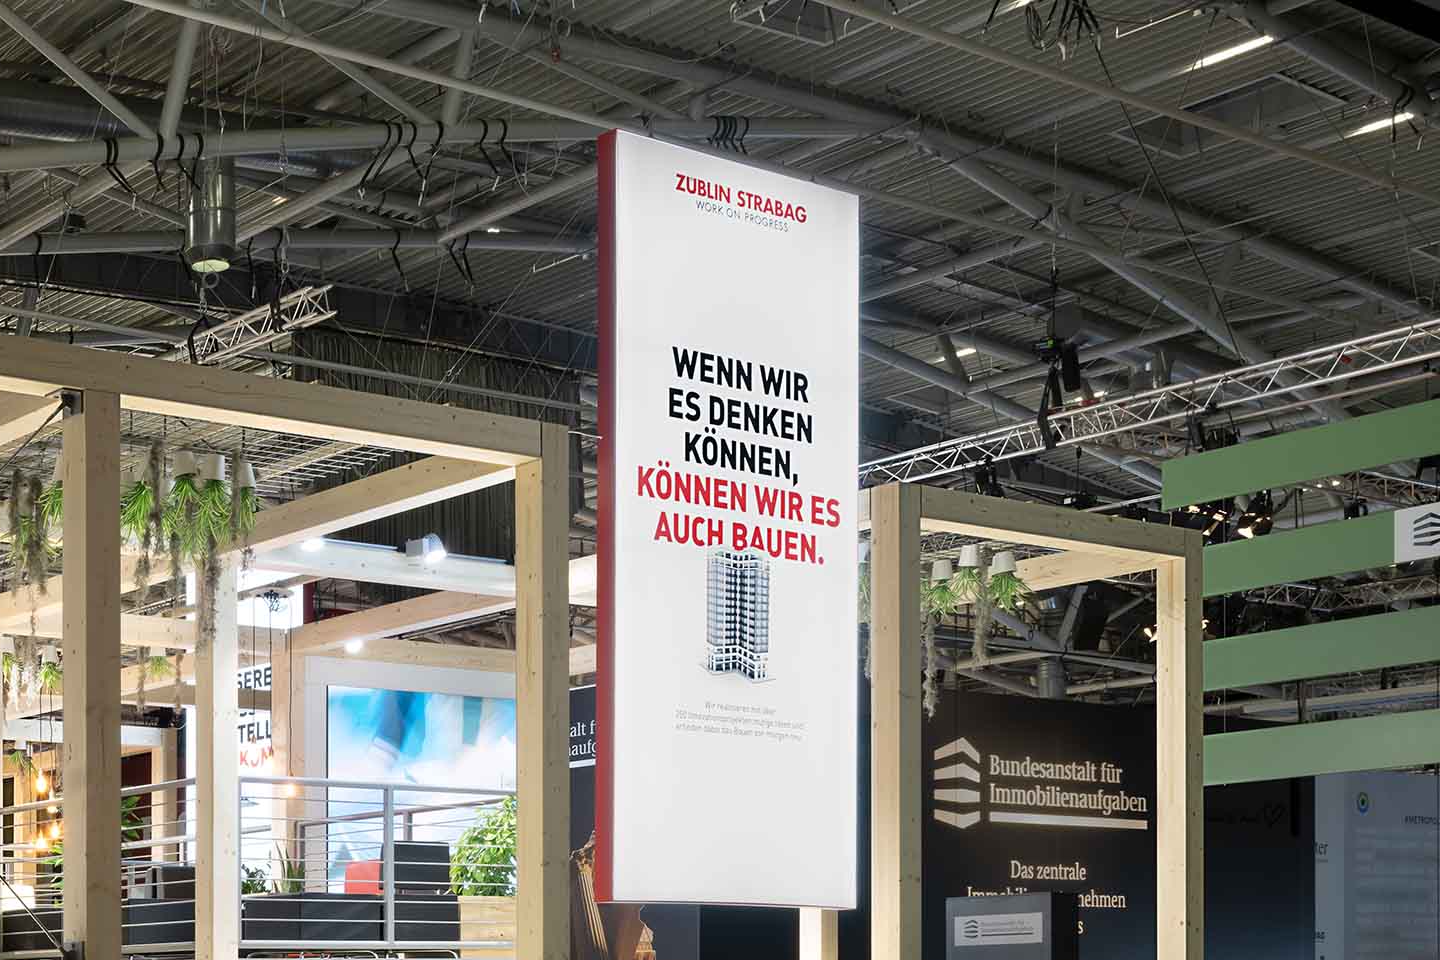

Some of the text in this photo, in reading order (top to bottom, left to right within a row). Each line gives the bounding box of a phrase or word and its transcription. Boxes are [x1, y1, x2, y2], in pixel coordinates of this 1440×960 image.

[696, 200, 789, 232] WORK ON PROGRESS
[737, 190, 807, 223] STRABAG
[672, 346, 809, 403] WENN WIR
[669, 387, 813, 443] ES DENKEN
[684, 426, 798, 487] KÖNNEN,
[637, 460, 841, 528] KÖNNEN WIR ES
[654, 511, 824, 565] AUCH BAUEN.
[989, 754, 1123, 783] Bundesanstalt für
[989, 783, 1147, 815] Immobilienaufgaben
[1010, 860, 1087, 881] Das zentrale
